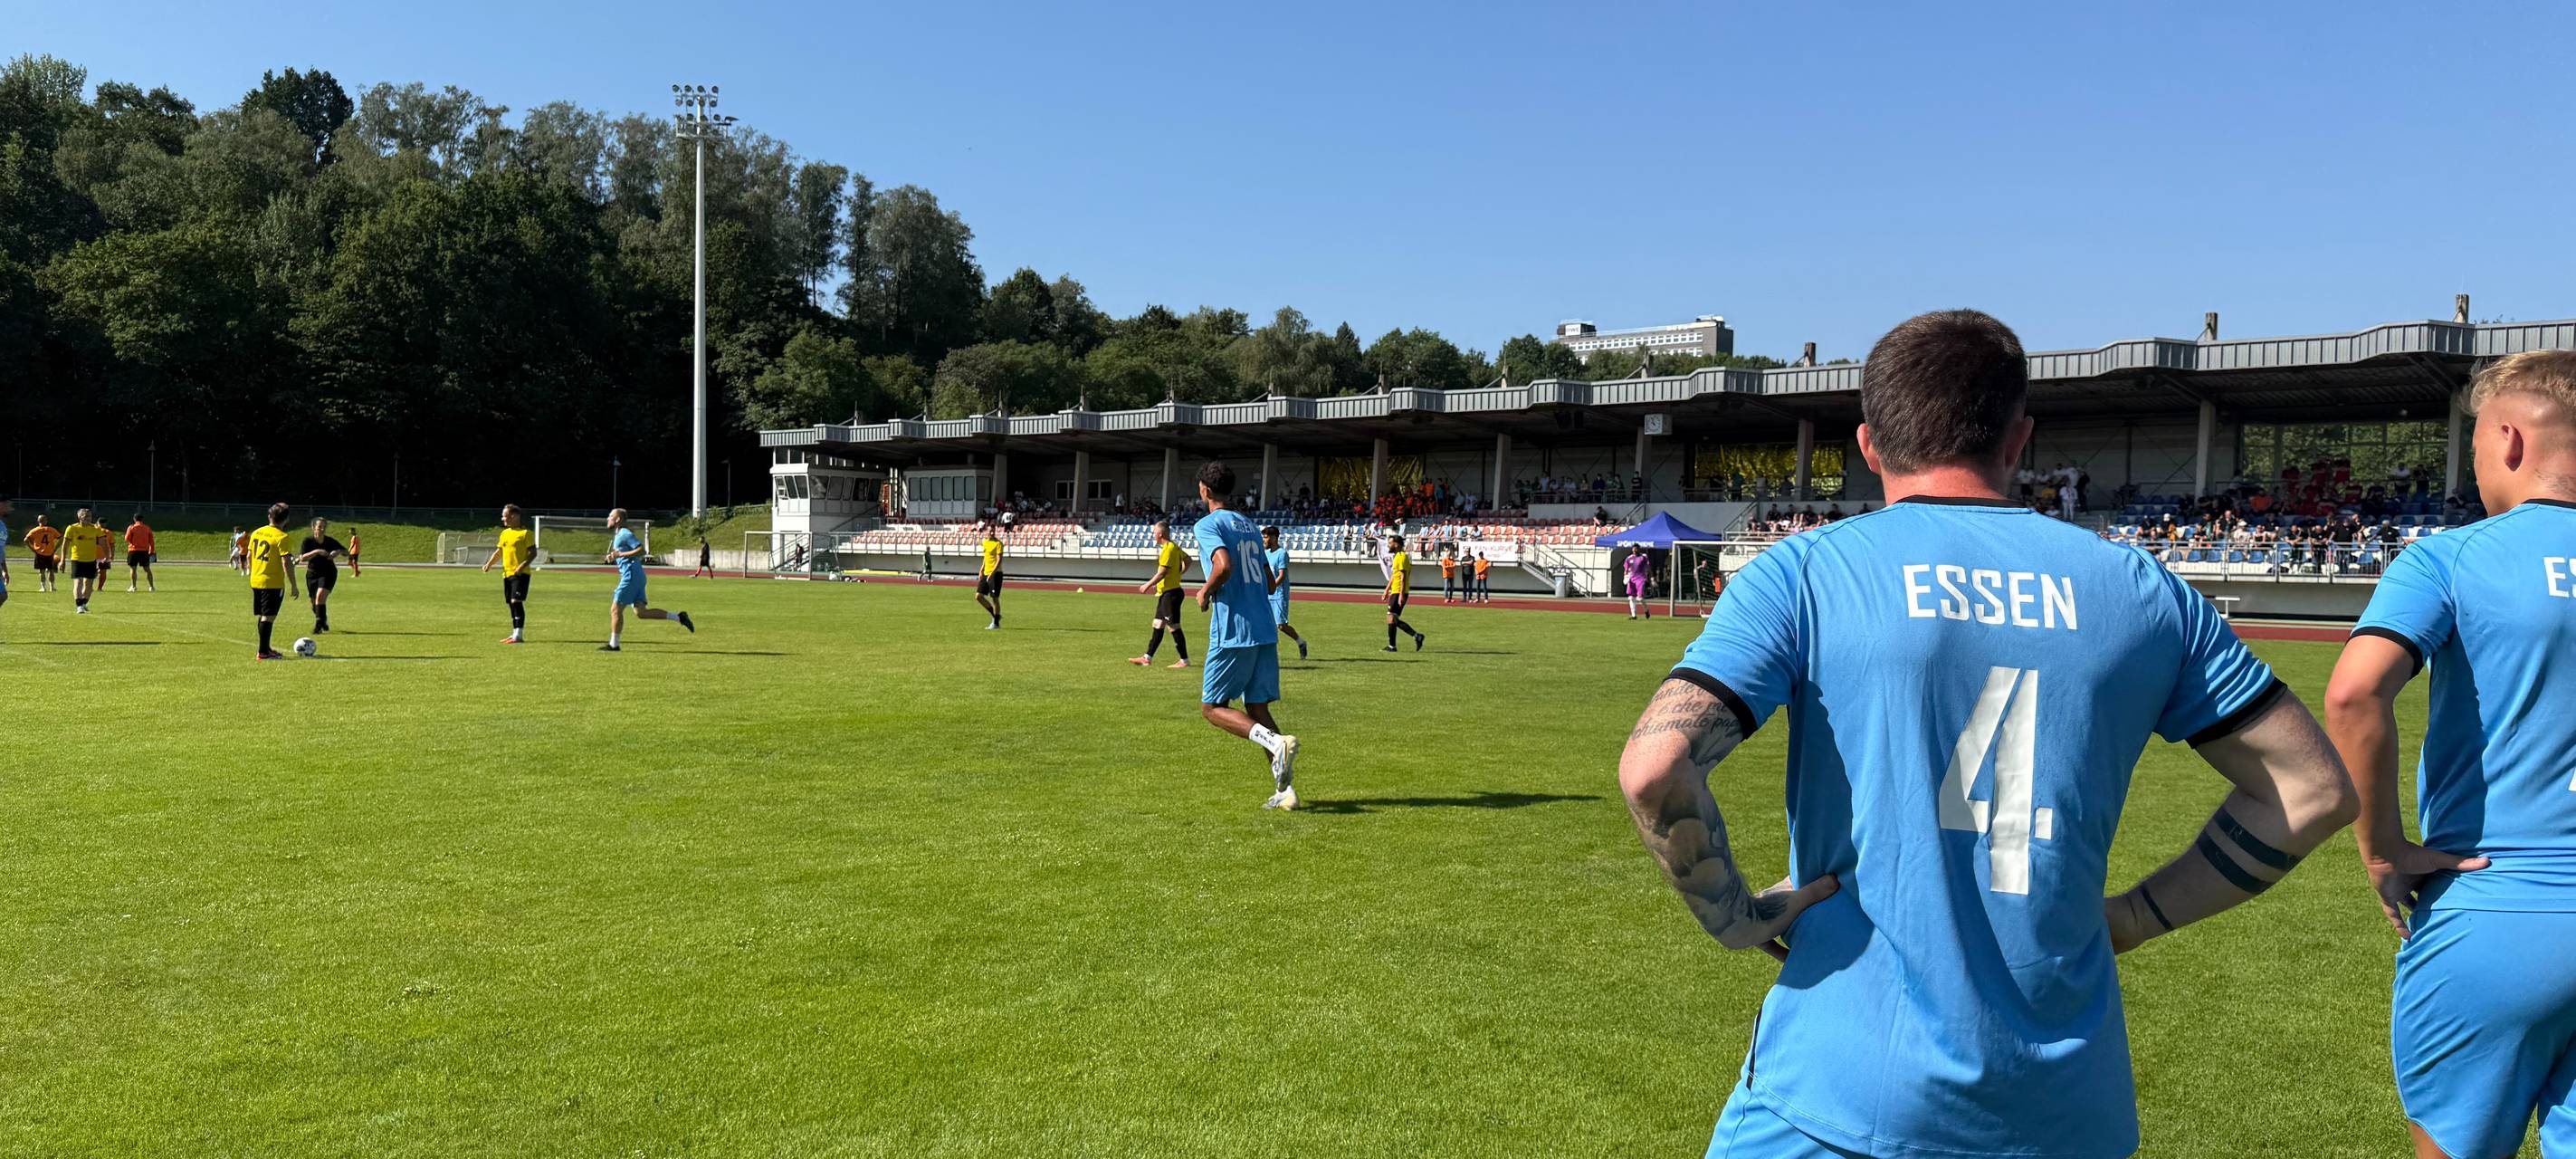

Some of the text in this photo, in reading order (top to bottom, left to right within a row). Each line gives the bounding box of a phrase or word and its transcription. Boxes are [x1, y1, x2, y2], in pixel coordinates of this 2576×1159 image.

[42, 533, 49, 545] 4
[253, 539, 270, 561] 12
[1237, 540, 1263, 584] 16
[1903, 564, 2078, 631] ESSEN
